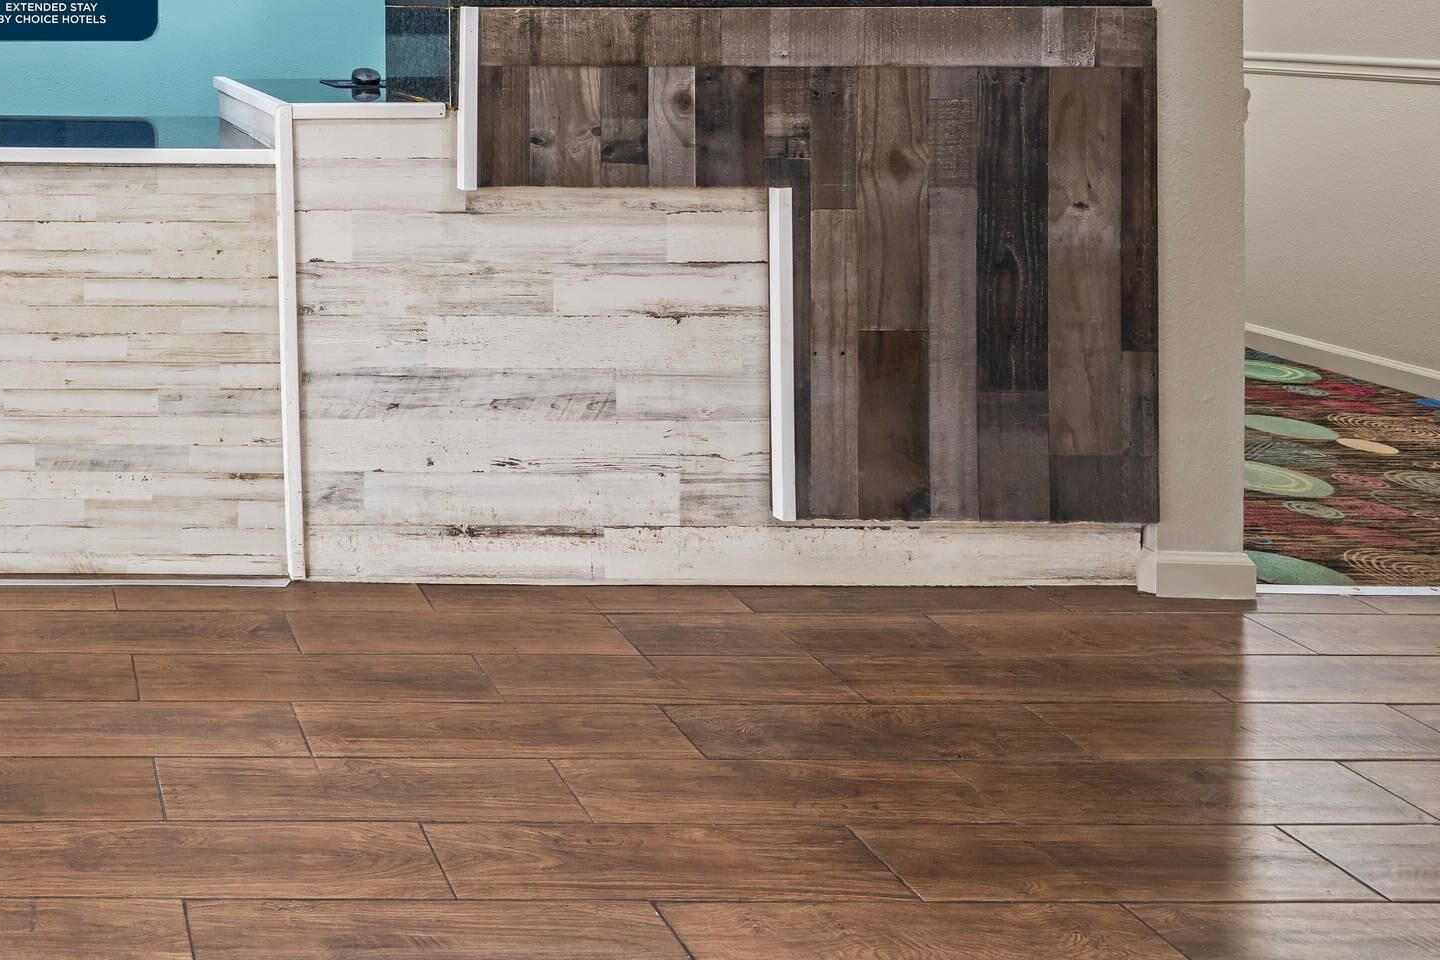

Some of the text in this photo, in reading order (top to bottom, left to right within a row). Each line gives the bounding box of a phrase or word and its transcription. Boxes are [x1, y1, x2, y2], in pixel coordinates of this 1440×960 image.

[5, 2, 98, 12] EXTENDED STAY
[14, 14, 59, 24] CHOICE
[62, 14, 107, 24] HOTELS
